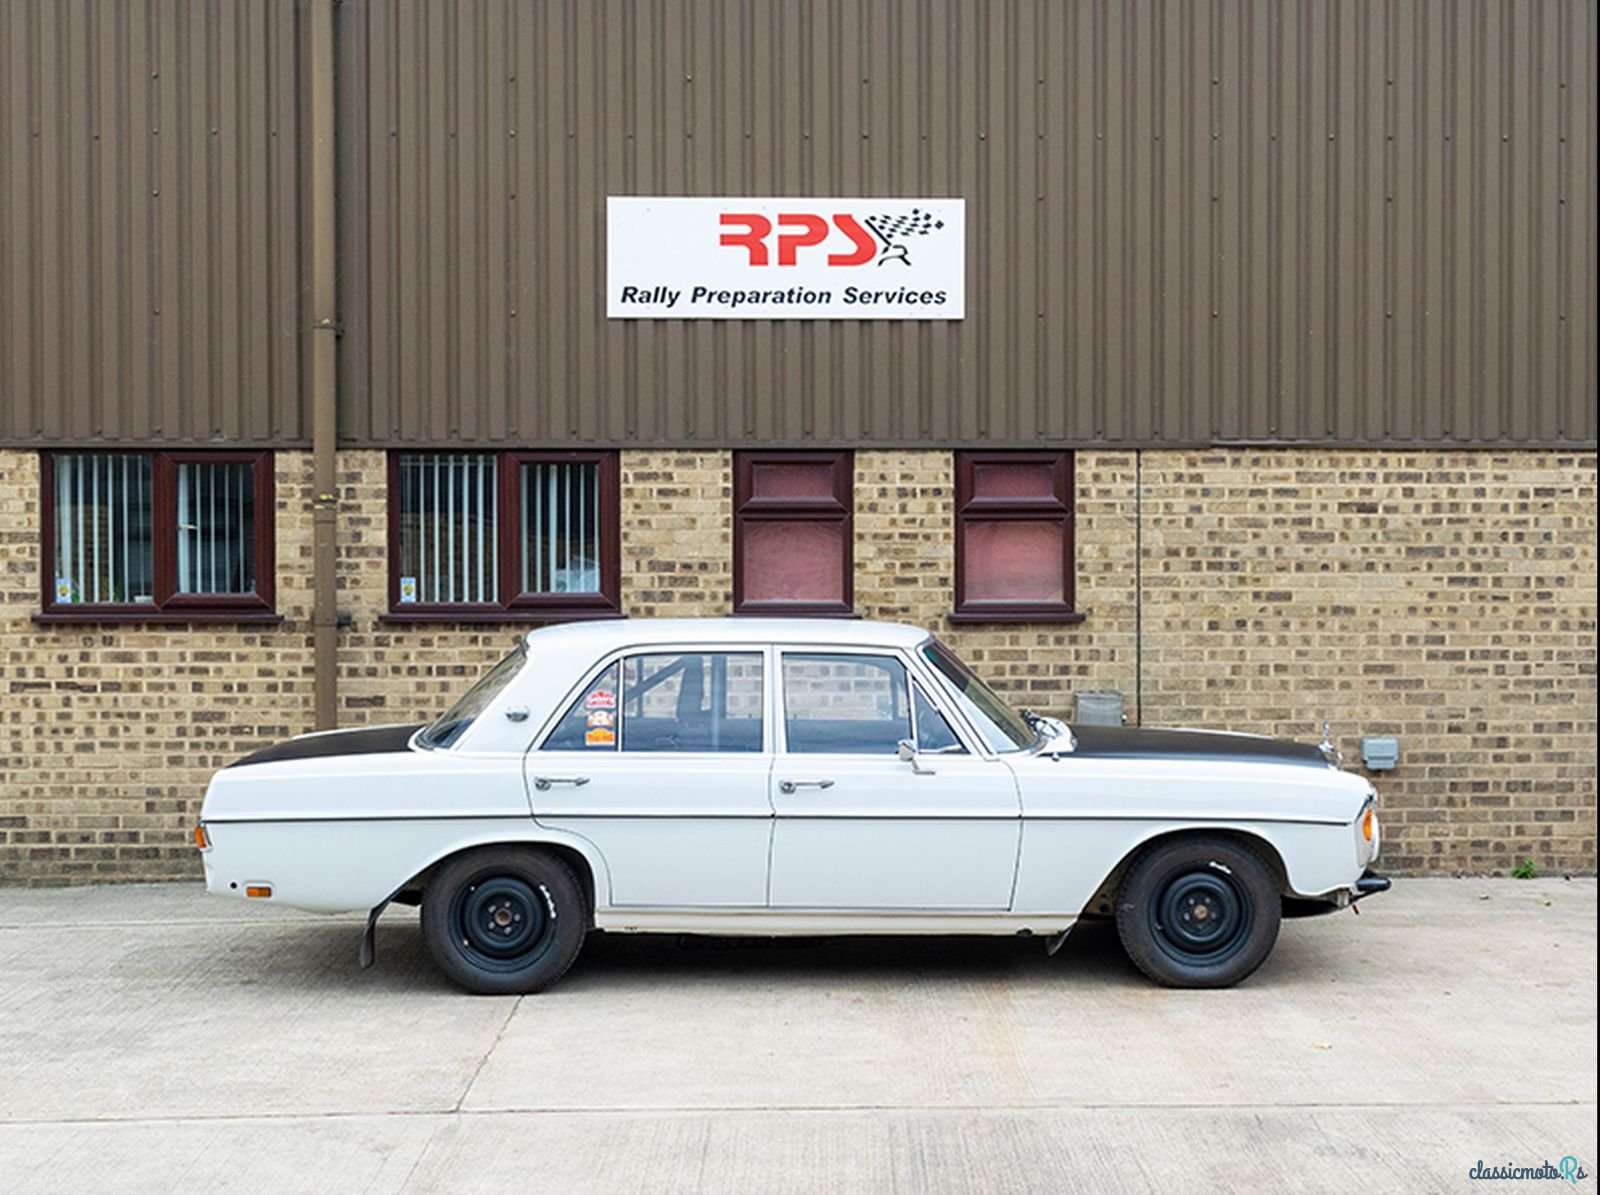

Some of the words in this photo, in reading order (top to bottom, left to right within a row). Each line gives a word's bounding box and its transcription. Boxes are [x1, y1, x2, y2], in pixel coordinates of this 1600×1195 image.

[719, 213, 878, 267] RPS
[620, 286, 681, 308] Rally
[691, 286, 832, 308] Preparation
[843, 286, 948, 305] Services
